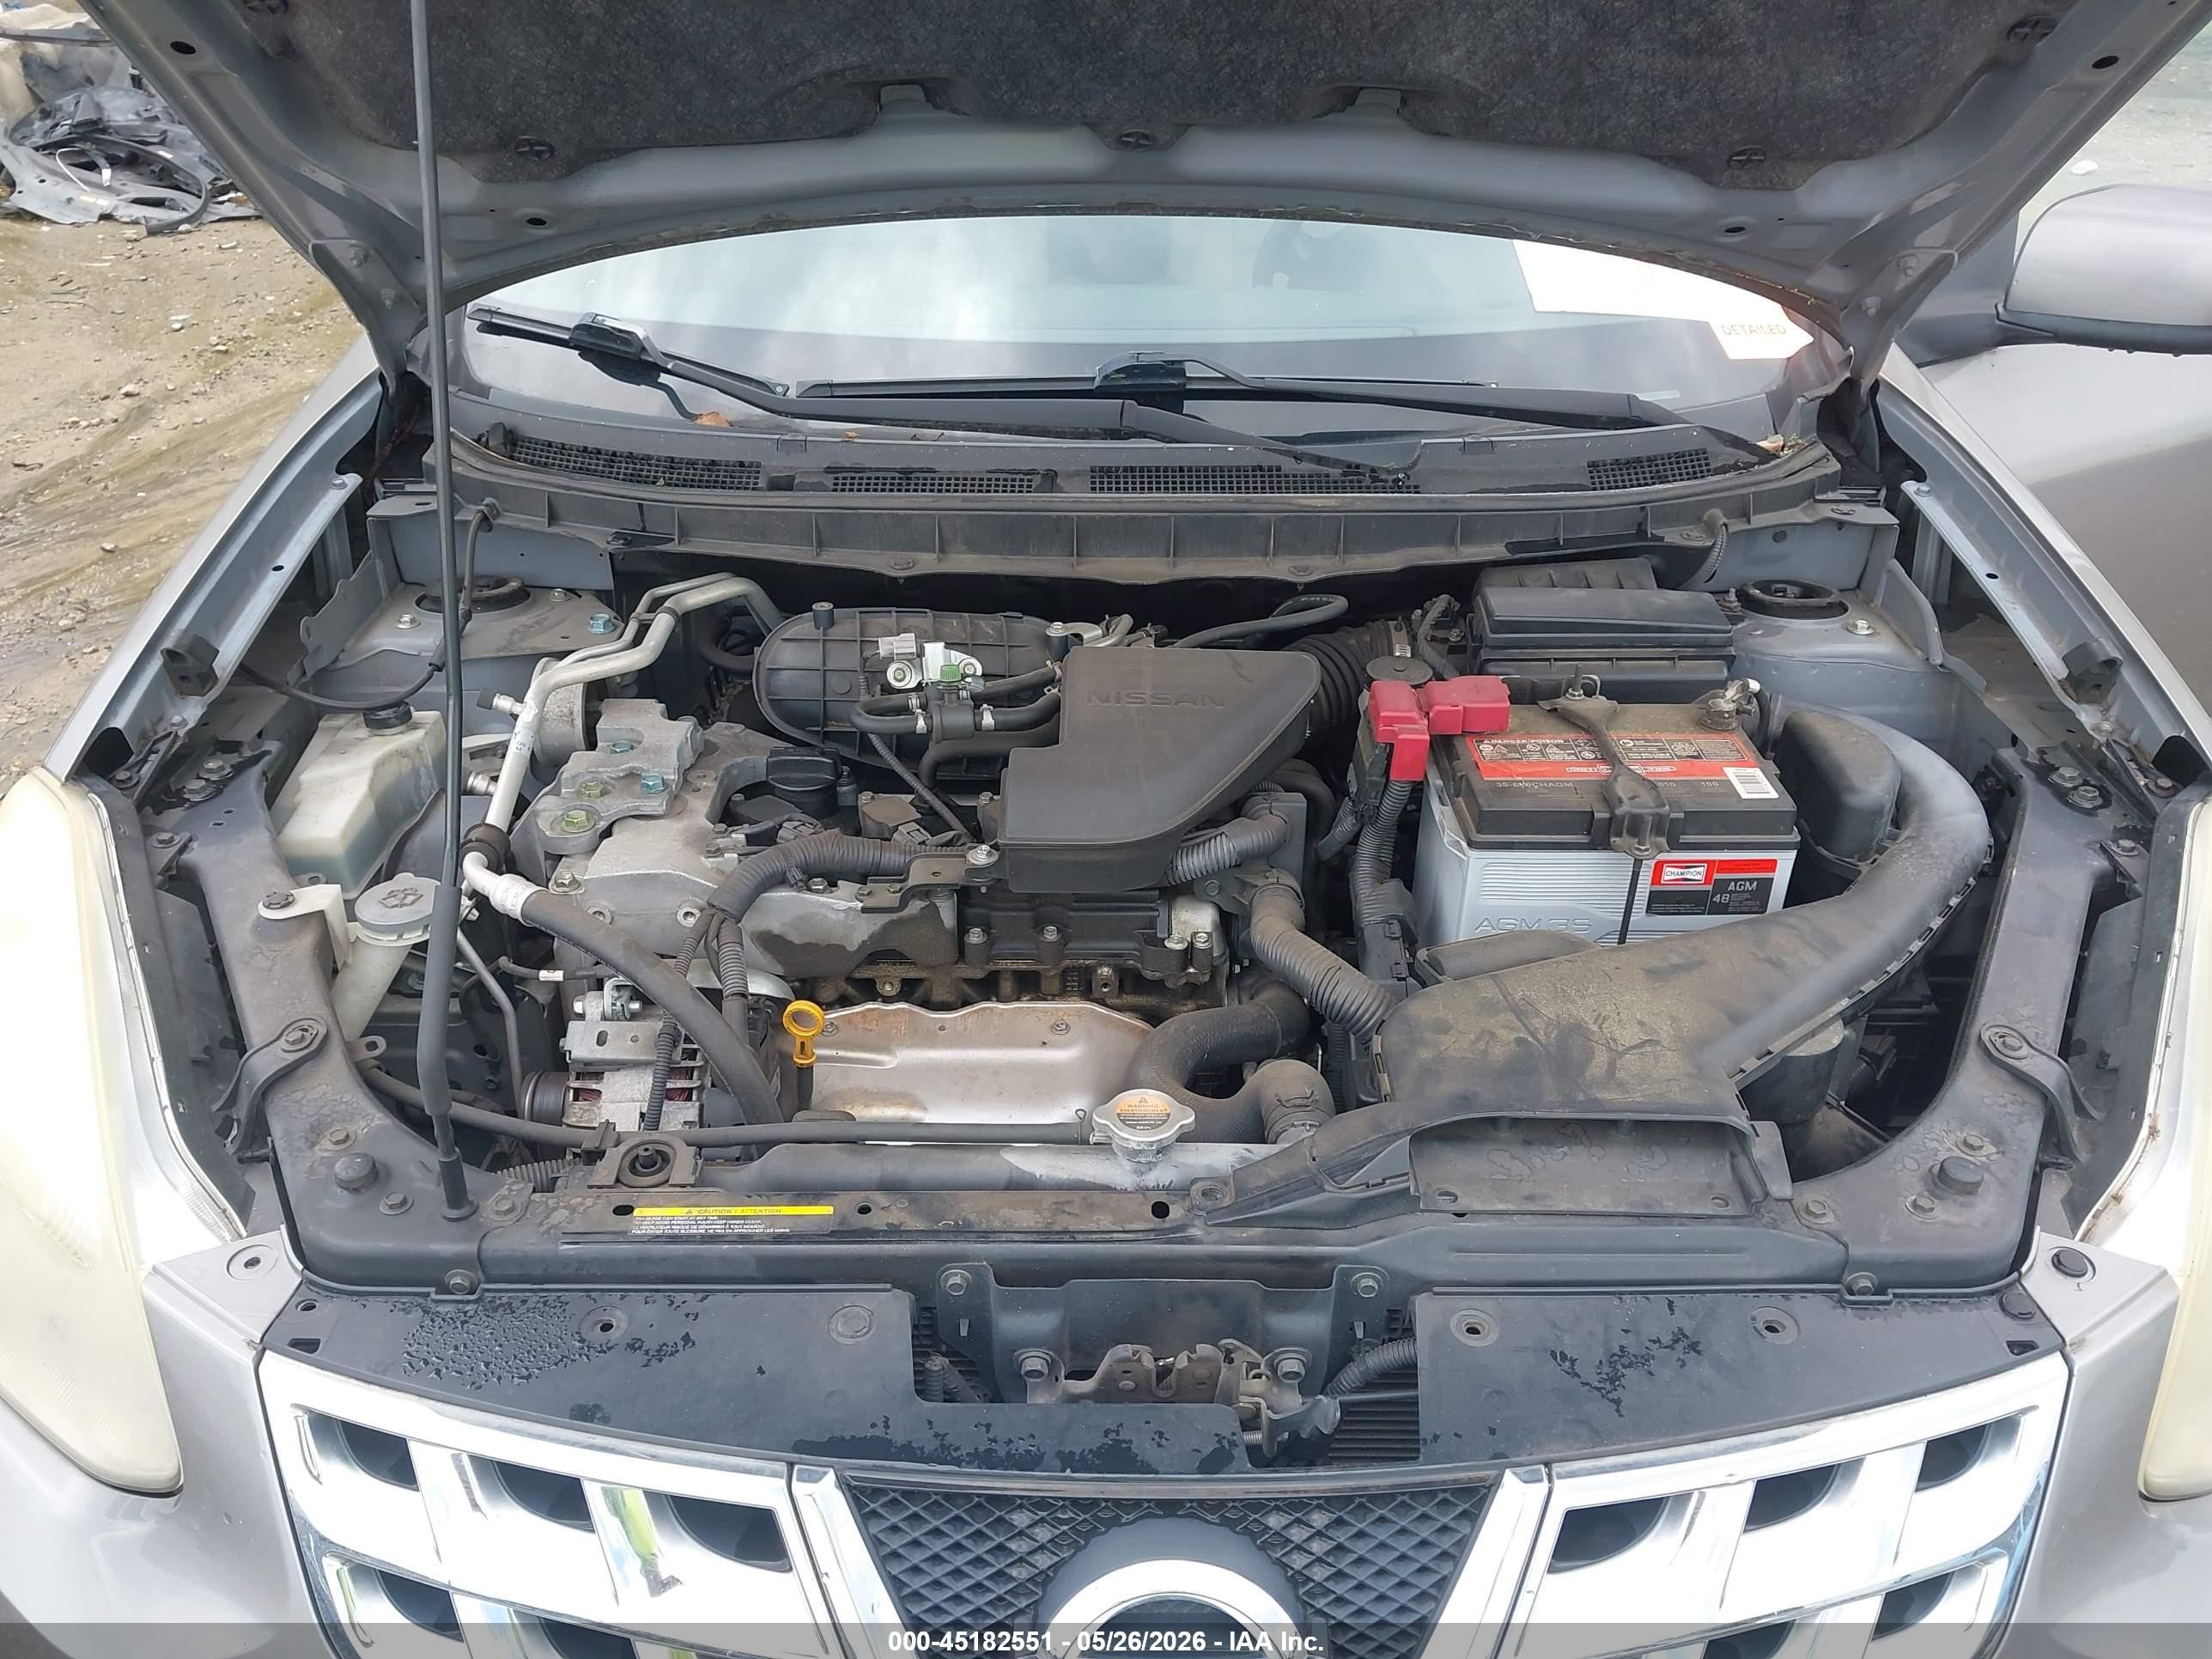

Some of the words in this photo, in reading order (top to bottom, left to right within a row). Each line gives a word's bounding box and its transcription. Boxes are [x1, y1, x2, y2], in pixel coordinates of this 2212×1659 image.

[1720, 324, 1787, 336] DETAILED
[1085, 690, 1226, 708] NISSAN
[1727, 880, 1758, 892] AGM
[1712, 893, 1730, 904] 48
[1474, 917, 1542, 933] AGM
